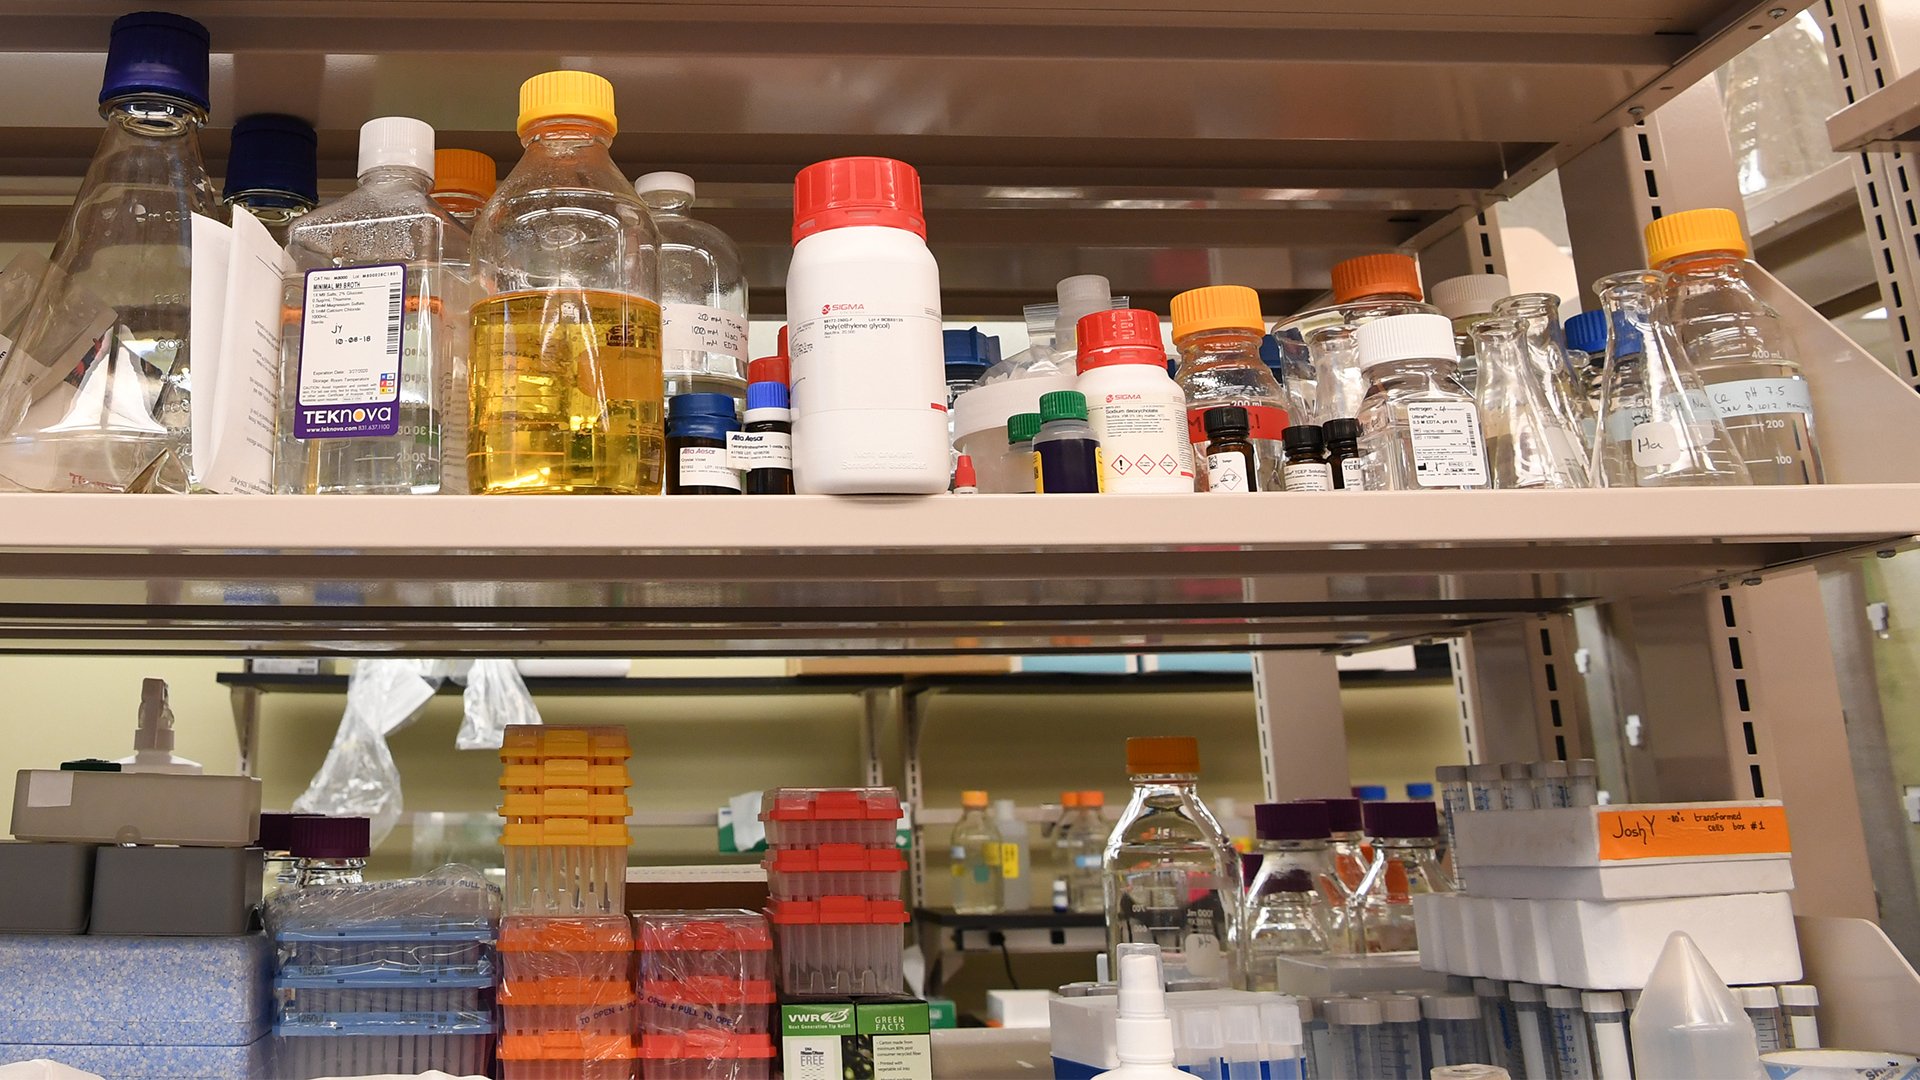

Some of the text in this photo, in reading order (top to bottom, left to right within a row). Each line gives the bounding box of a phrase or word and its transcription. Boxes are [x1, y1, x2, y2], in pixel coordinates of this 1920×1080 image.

[1752, 350, 1770, 359] 400
[1766, 420, 1784, 428] 200
[1776, 456, 1792, 464] 100
[1694, 812, 1741, 822] transformed
[1708, 823, 1724, 831] cells
[1732, 822, 1746, 830] box
[580, 1007, 615, 1025] TO OPEN
[678, 1004, 698, 1017] PULL
[703, 1010, 713, 1020] TO
[788, 1014, 820, 1022] VWR
[801, 1055, 824, 1066] FREE
